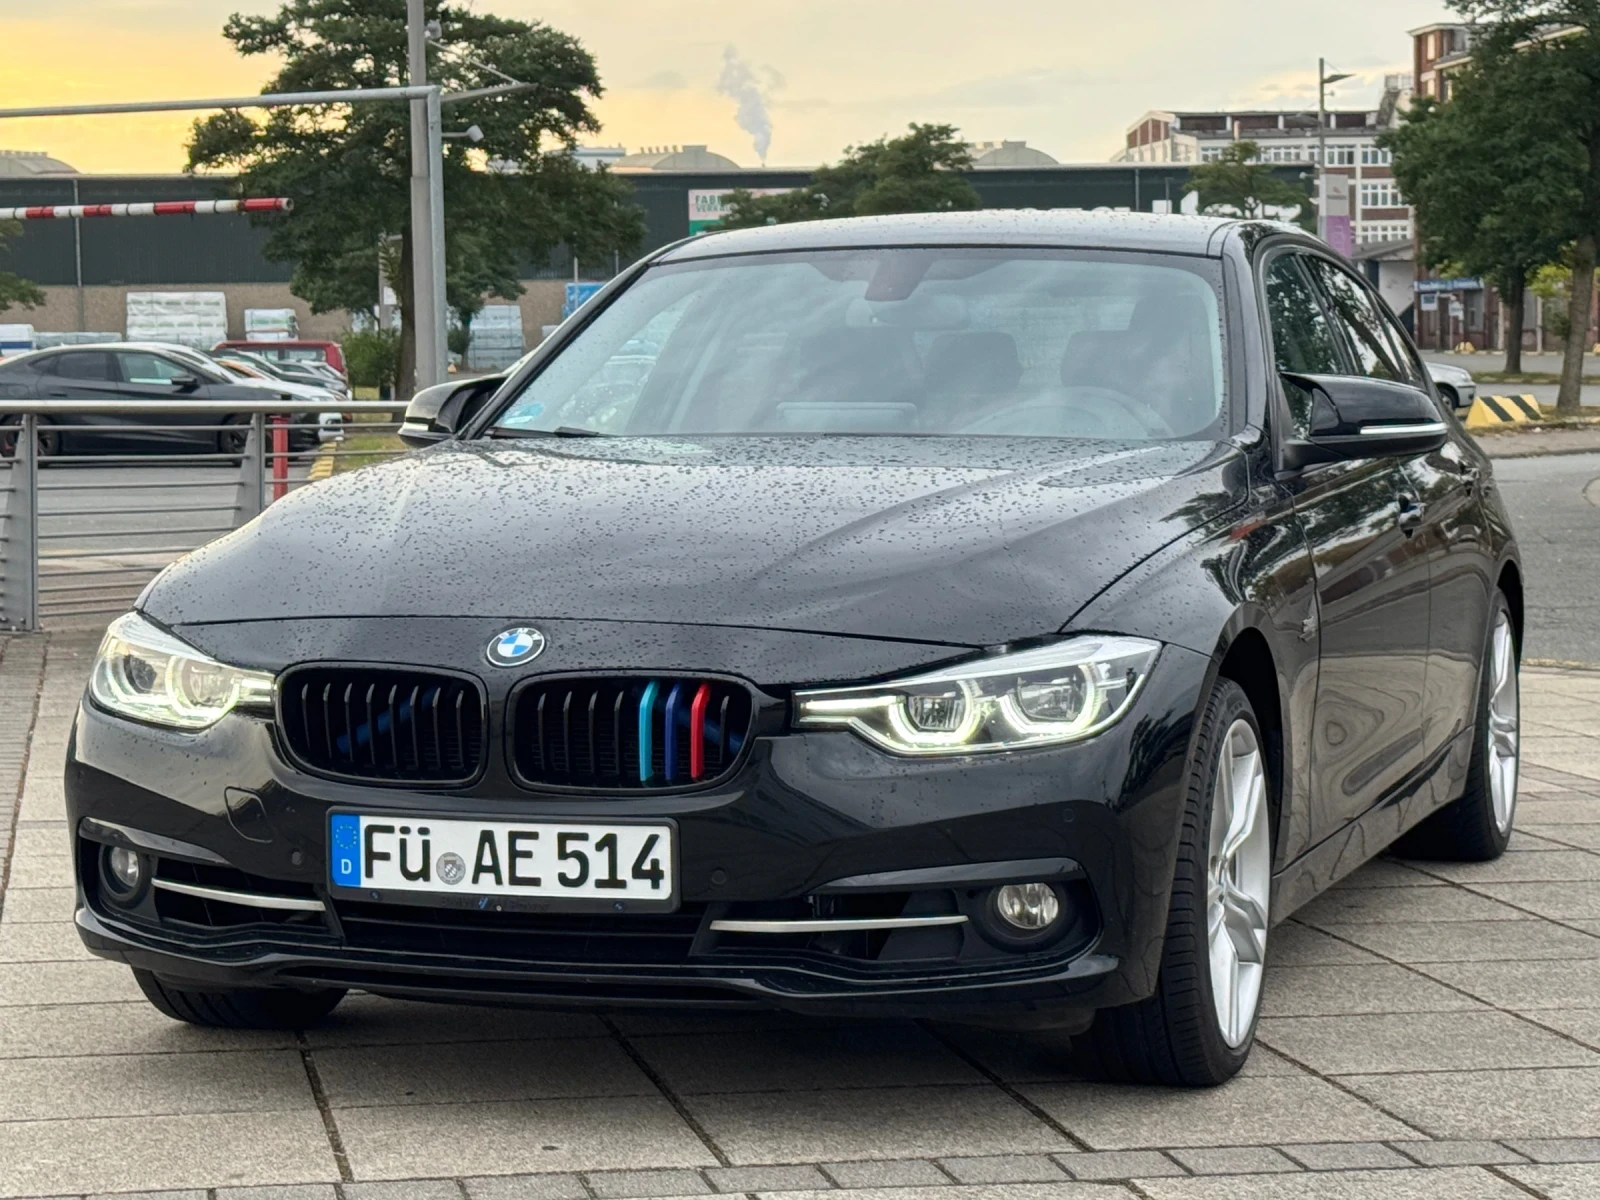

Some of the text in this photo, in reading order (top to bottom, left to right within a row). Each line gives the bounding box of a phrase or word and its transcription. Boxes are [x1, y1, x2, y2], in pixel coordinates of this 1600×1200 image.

[341, 859, 352, 875] D
[363, 824, 664, 888] FÜ AE 514
